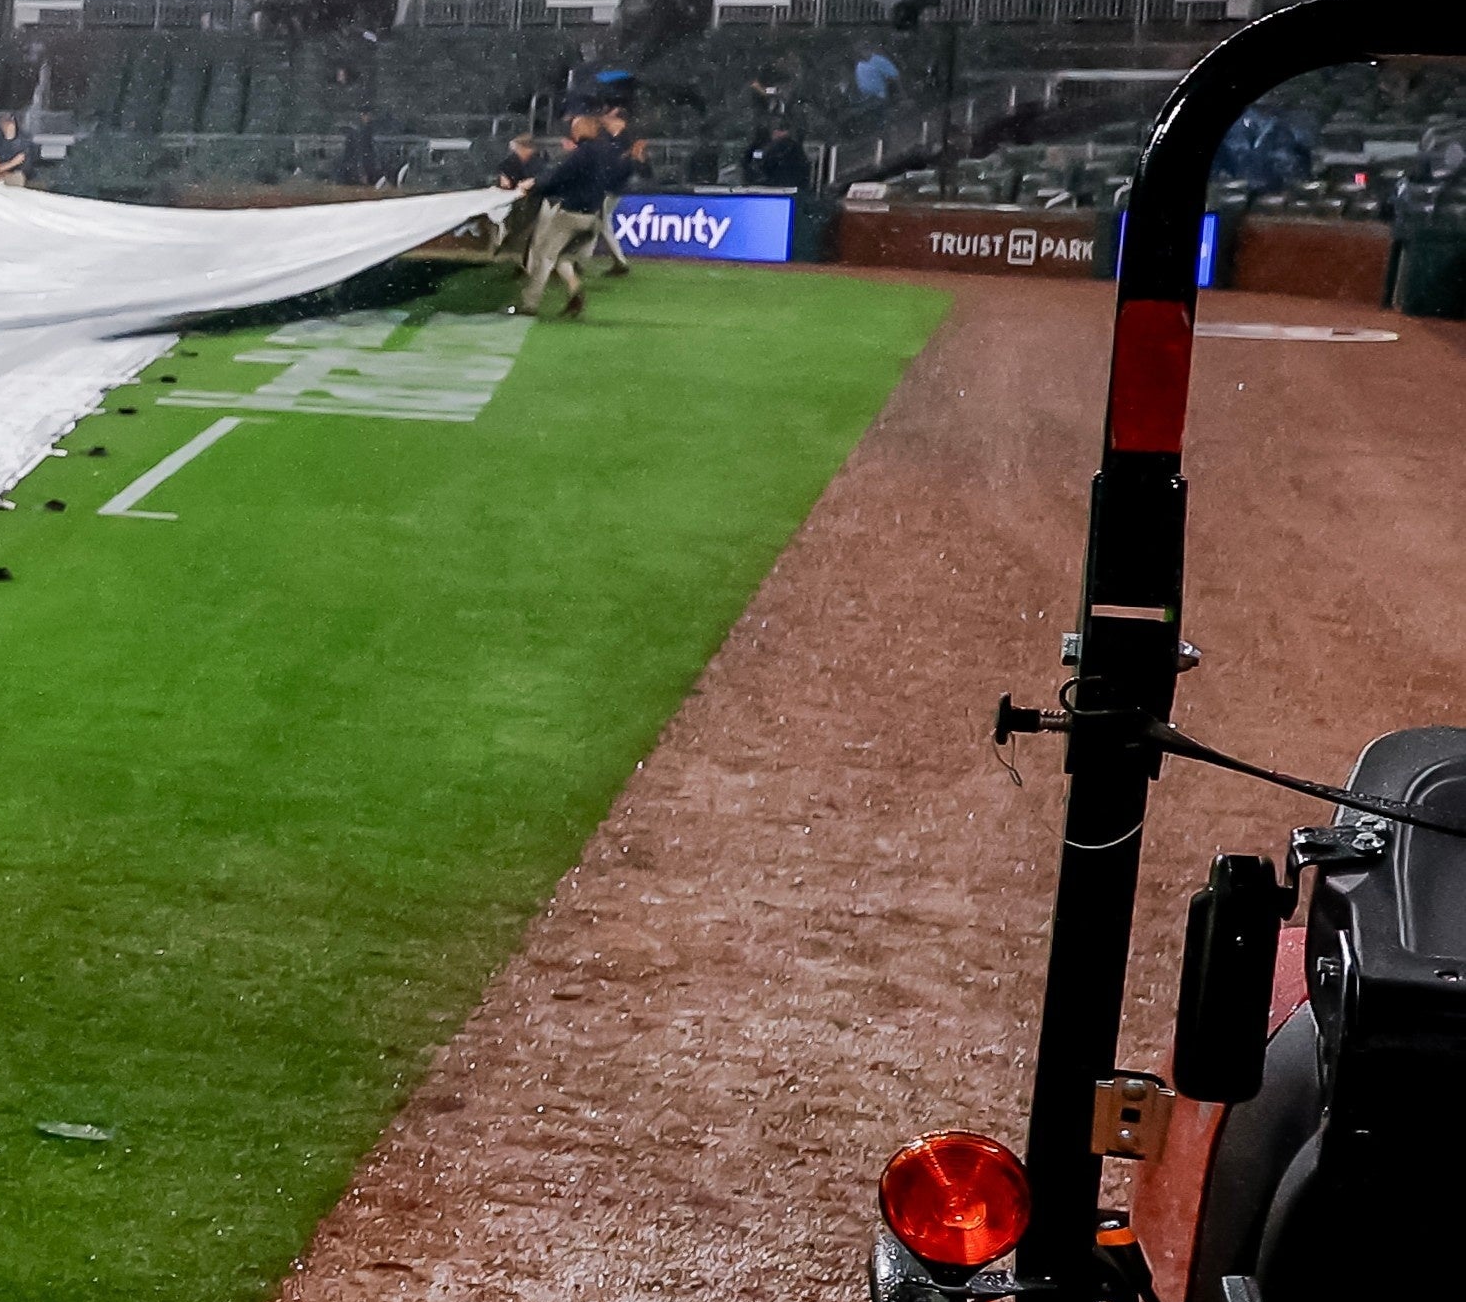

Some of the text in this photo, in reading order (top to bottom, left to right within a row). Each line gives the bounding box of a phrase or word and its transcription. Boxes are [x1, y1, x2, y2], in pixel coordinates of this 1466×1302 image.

[615, 204, 732, 249] xfinity
[929, 232, 1094, 261] TRUIST PARK
